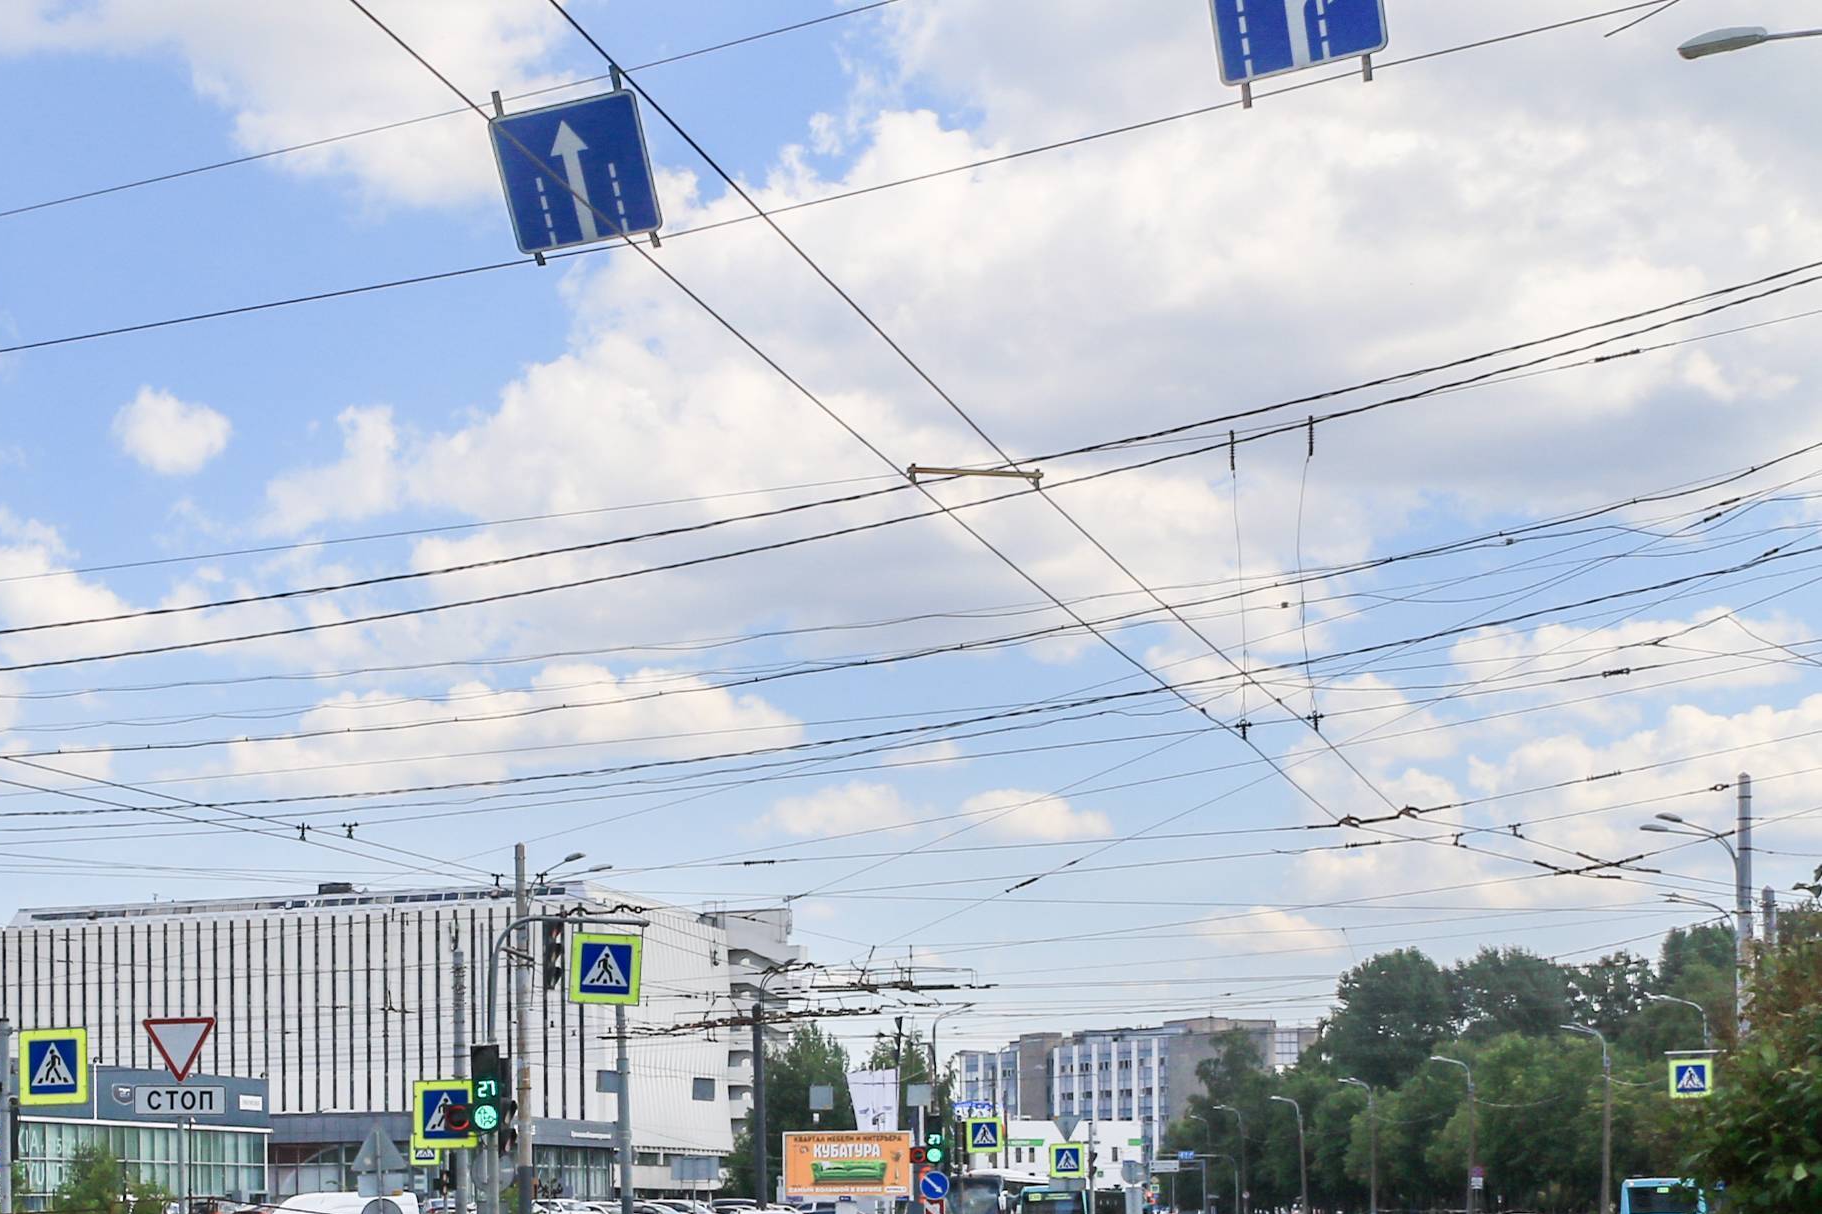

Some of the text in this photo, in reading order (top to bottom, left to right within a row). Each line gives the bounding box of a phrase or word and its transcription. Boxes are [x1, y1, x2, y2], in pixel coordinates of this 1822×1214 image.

[478, 1080, 496, 1098] 27
[147, 1090, 214, 1111] СТОП
[813, 1143, 881, 1158] КУБАТУРА
